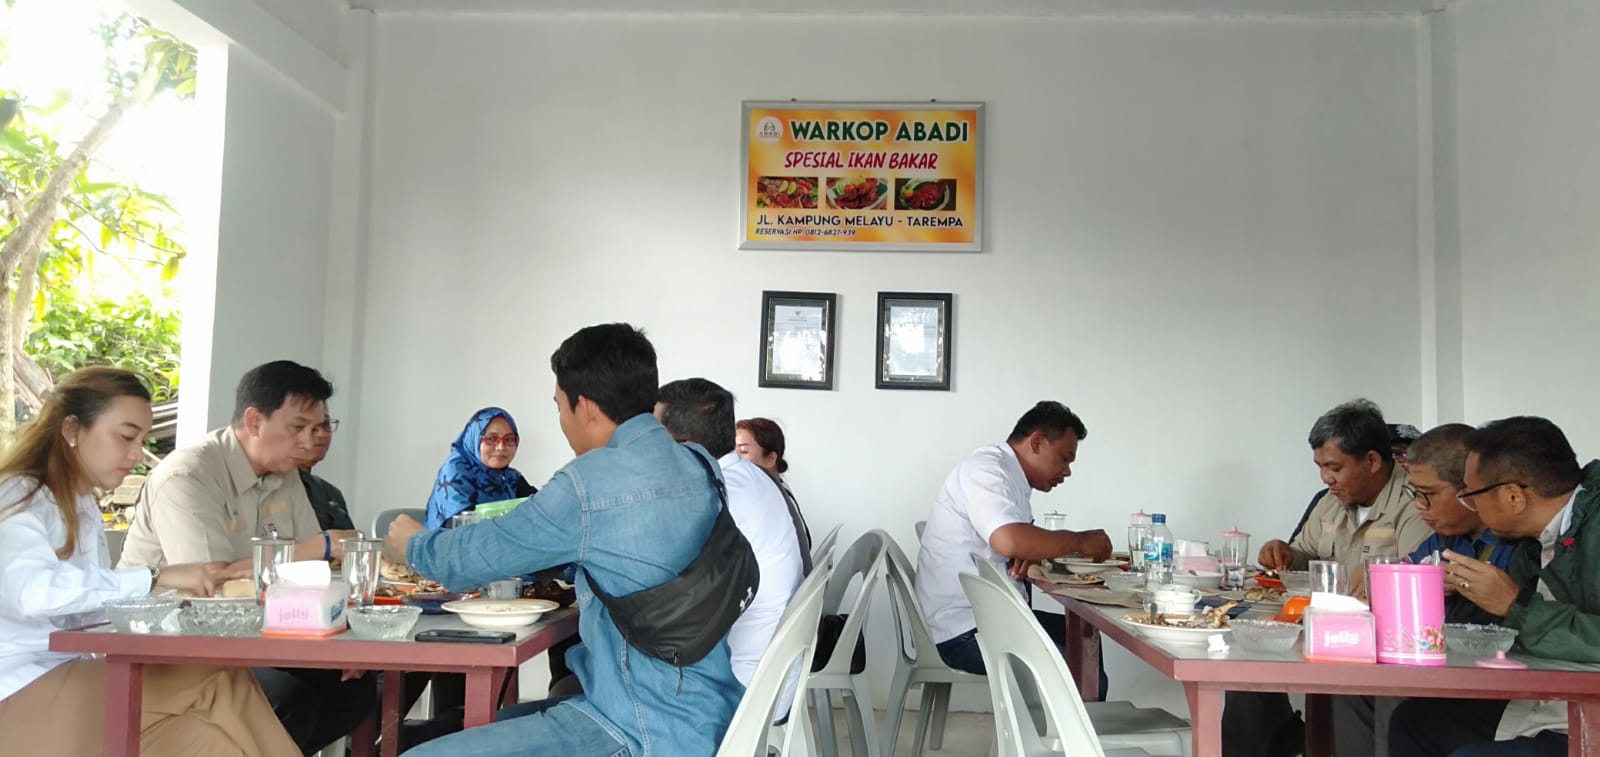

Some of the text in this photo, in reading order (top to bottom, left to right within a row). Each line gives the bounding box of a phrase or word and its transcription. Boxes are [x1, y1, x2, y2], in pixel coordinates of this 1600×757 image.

[790, 121, 968, 142] WARKOP ABADI
[784, 151, 938, 170] SPESIAL IKAN BAKAR
[757, 214, 773, 225] JL.
[777, 214, 841, 226] KAMPUNG
[845, 215, 894, 227] MELAYU
[907, 216, 963, 227] TAREMPA
[278, 607, 309, 623] jolly
[1324, 631, 1360, 648] jolly
